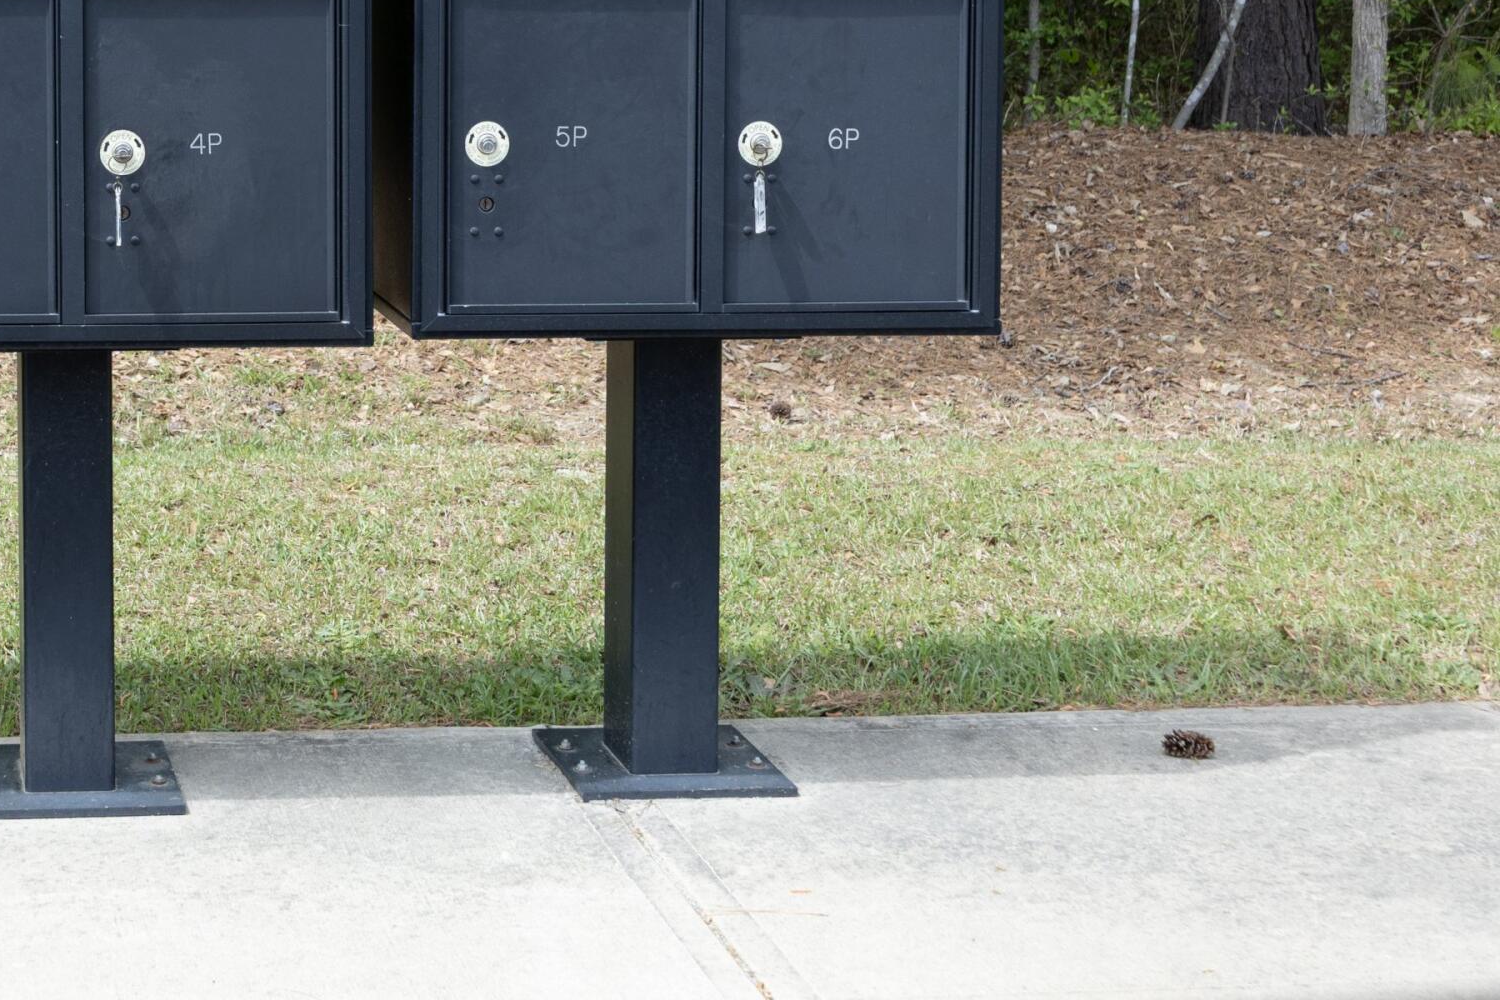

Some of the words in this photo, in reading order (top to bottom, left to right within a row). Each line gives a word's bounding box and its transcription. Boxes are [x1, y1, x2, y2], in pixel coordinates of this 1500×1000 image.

[110, 131, 132, 142] OPEN
[475, 123, 496, 133] OPEN
[555, 125, 588, 148] 5P
[748, 123, 769, 133] OPEN
[189, 132, 222, 155] 4P
[828, 127, 860, 150] 6P
